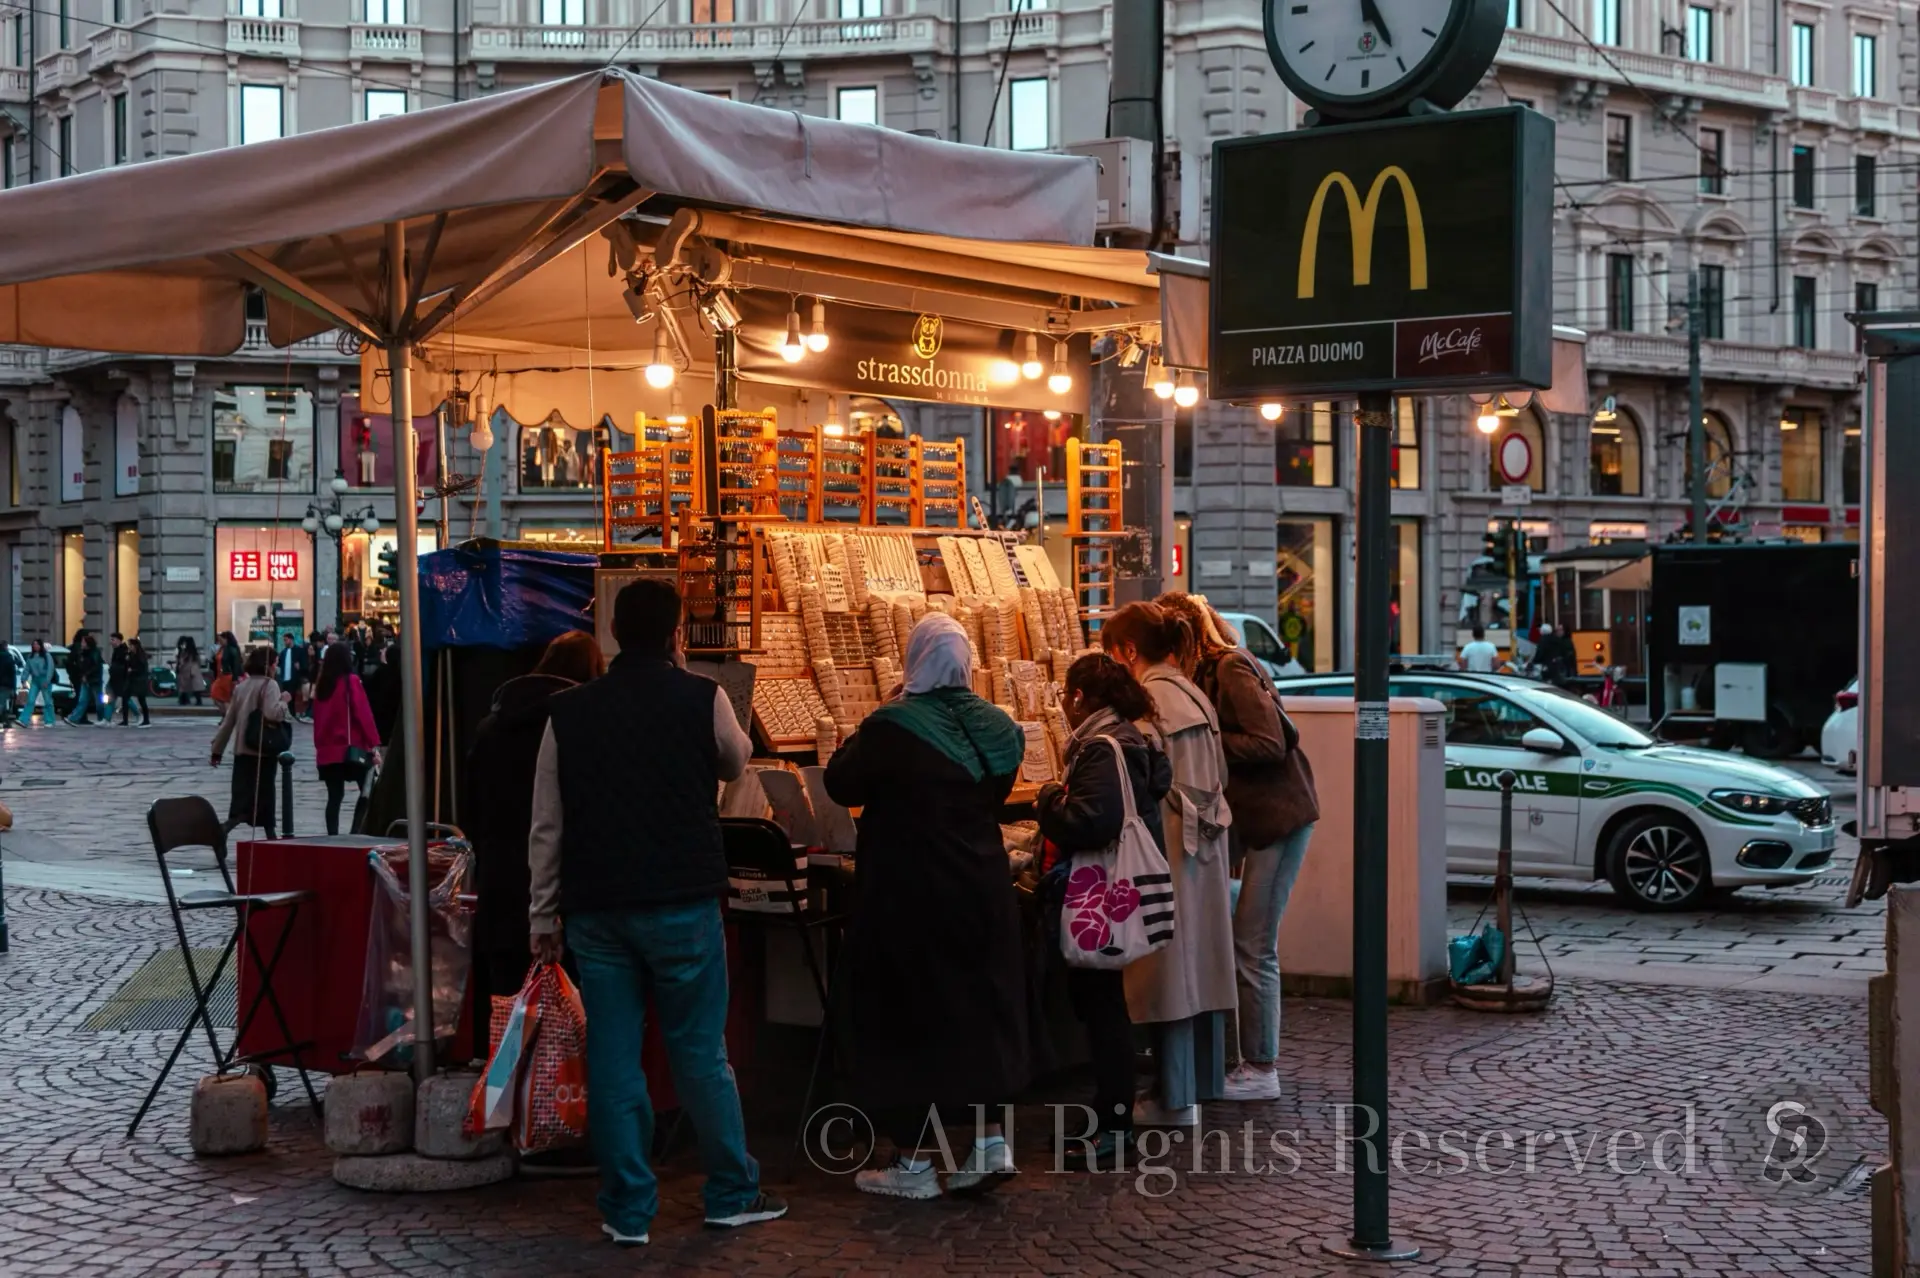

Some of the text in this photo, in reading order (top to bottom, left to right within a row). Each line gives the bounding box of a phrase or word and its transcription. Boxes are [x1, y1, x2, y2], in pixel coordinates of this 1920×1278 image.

[1252, 341, 1364, 367] PIAZZA DUOMO
[1419, 327, 1483, 363] McCafé
[857, 357, 988, 392] strassdonna
[270, 554, 293, 567] UNI
[270, 566, 295, 580] QLO
